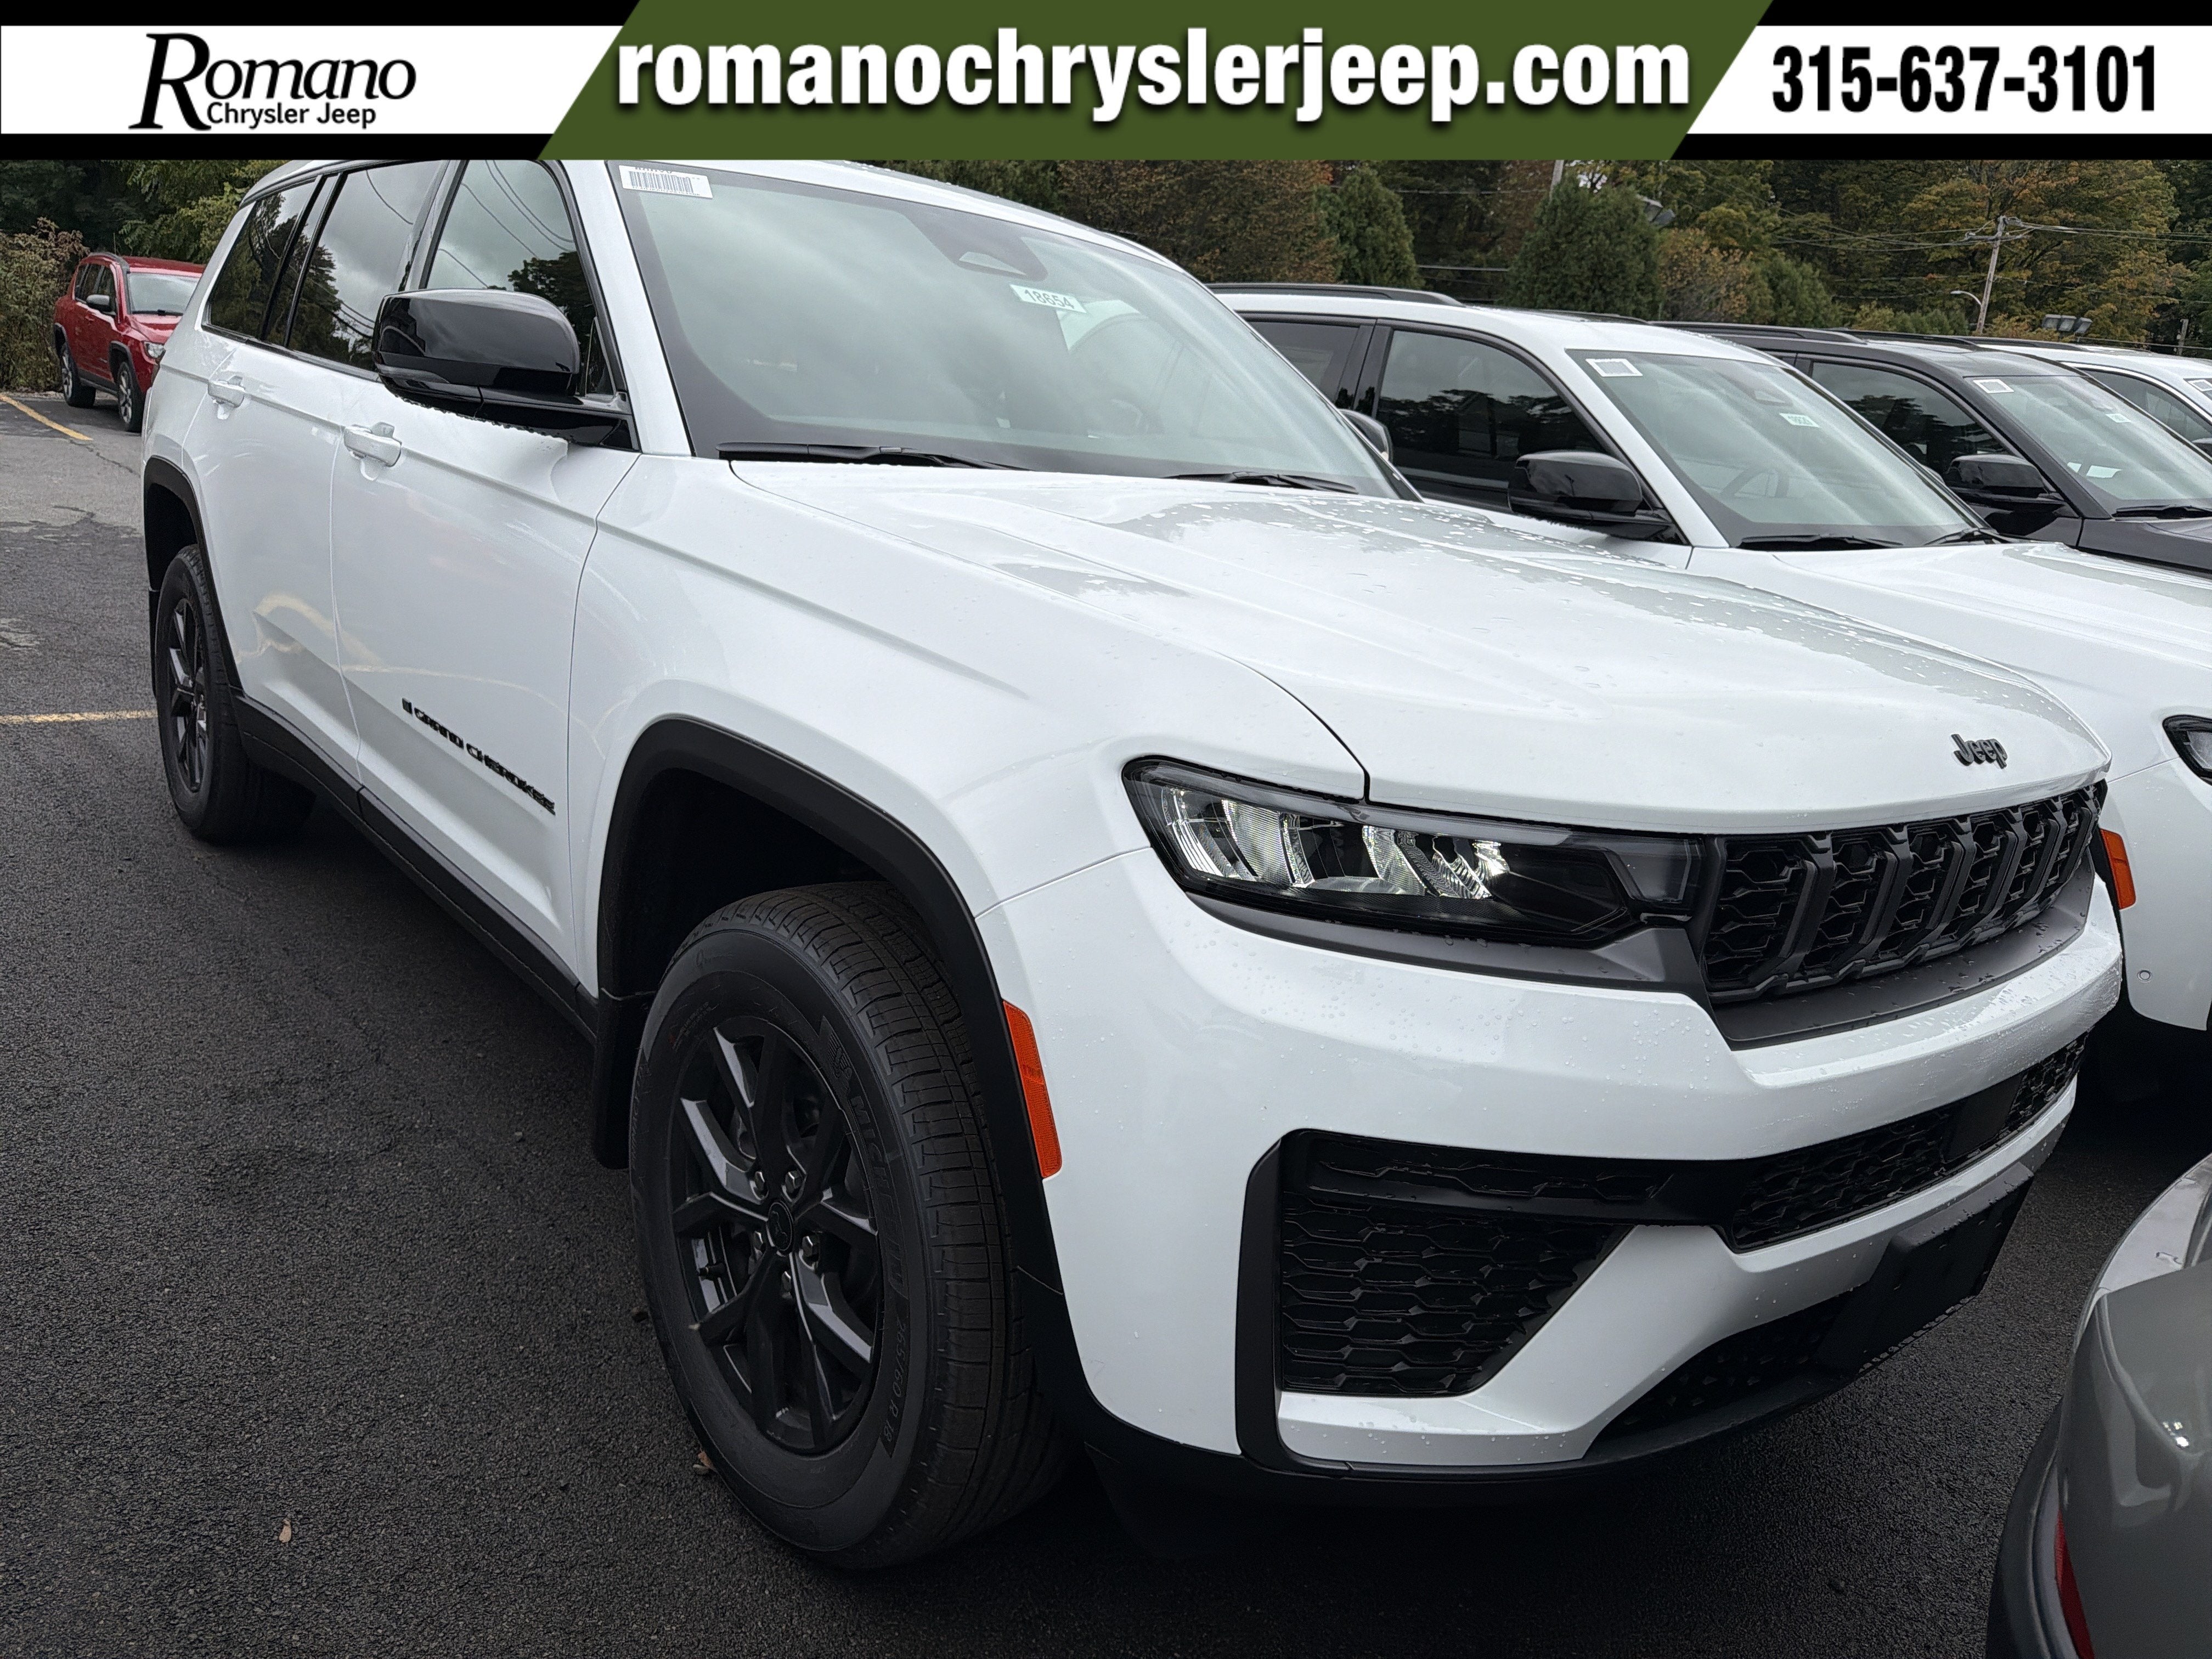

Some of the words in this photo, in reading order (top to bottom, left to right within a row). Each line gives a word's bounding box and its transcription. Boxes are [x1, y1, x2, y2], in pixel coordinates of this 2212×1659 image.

[1025, 289, 1075, 309] 18654
[414, 707, 464, 749] GRAND
[1951, 733, 2008, 769] Jeep
